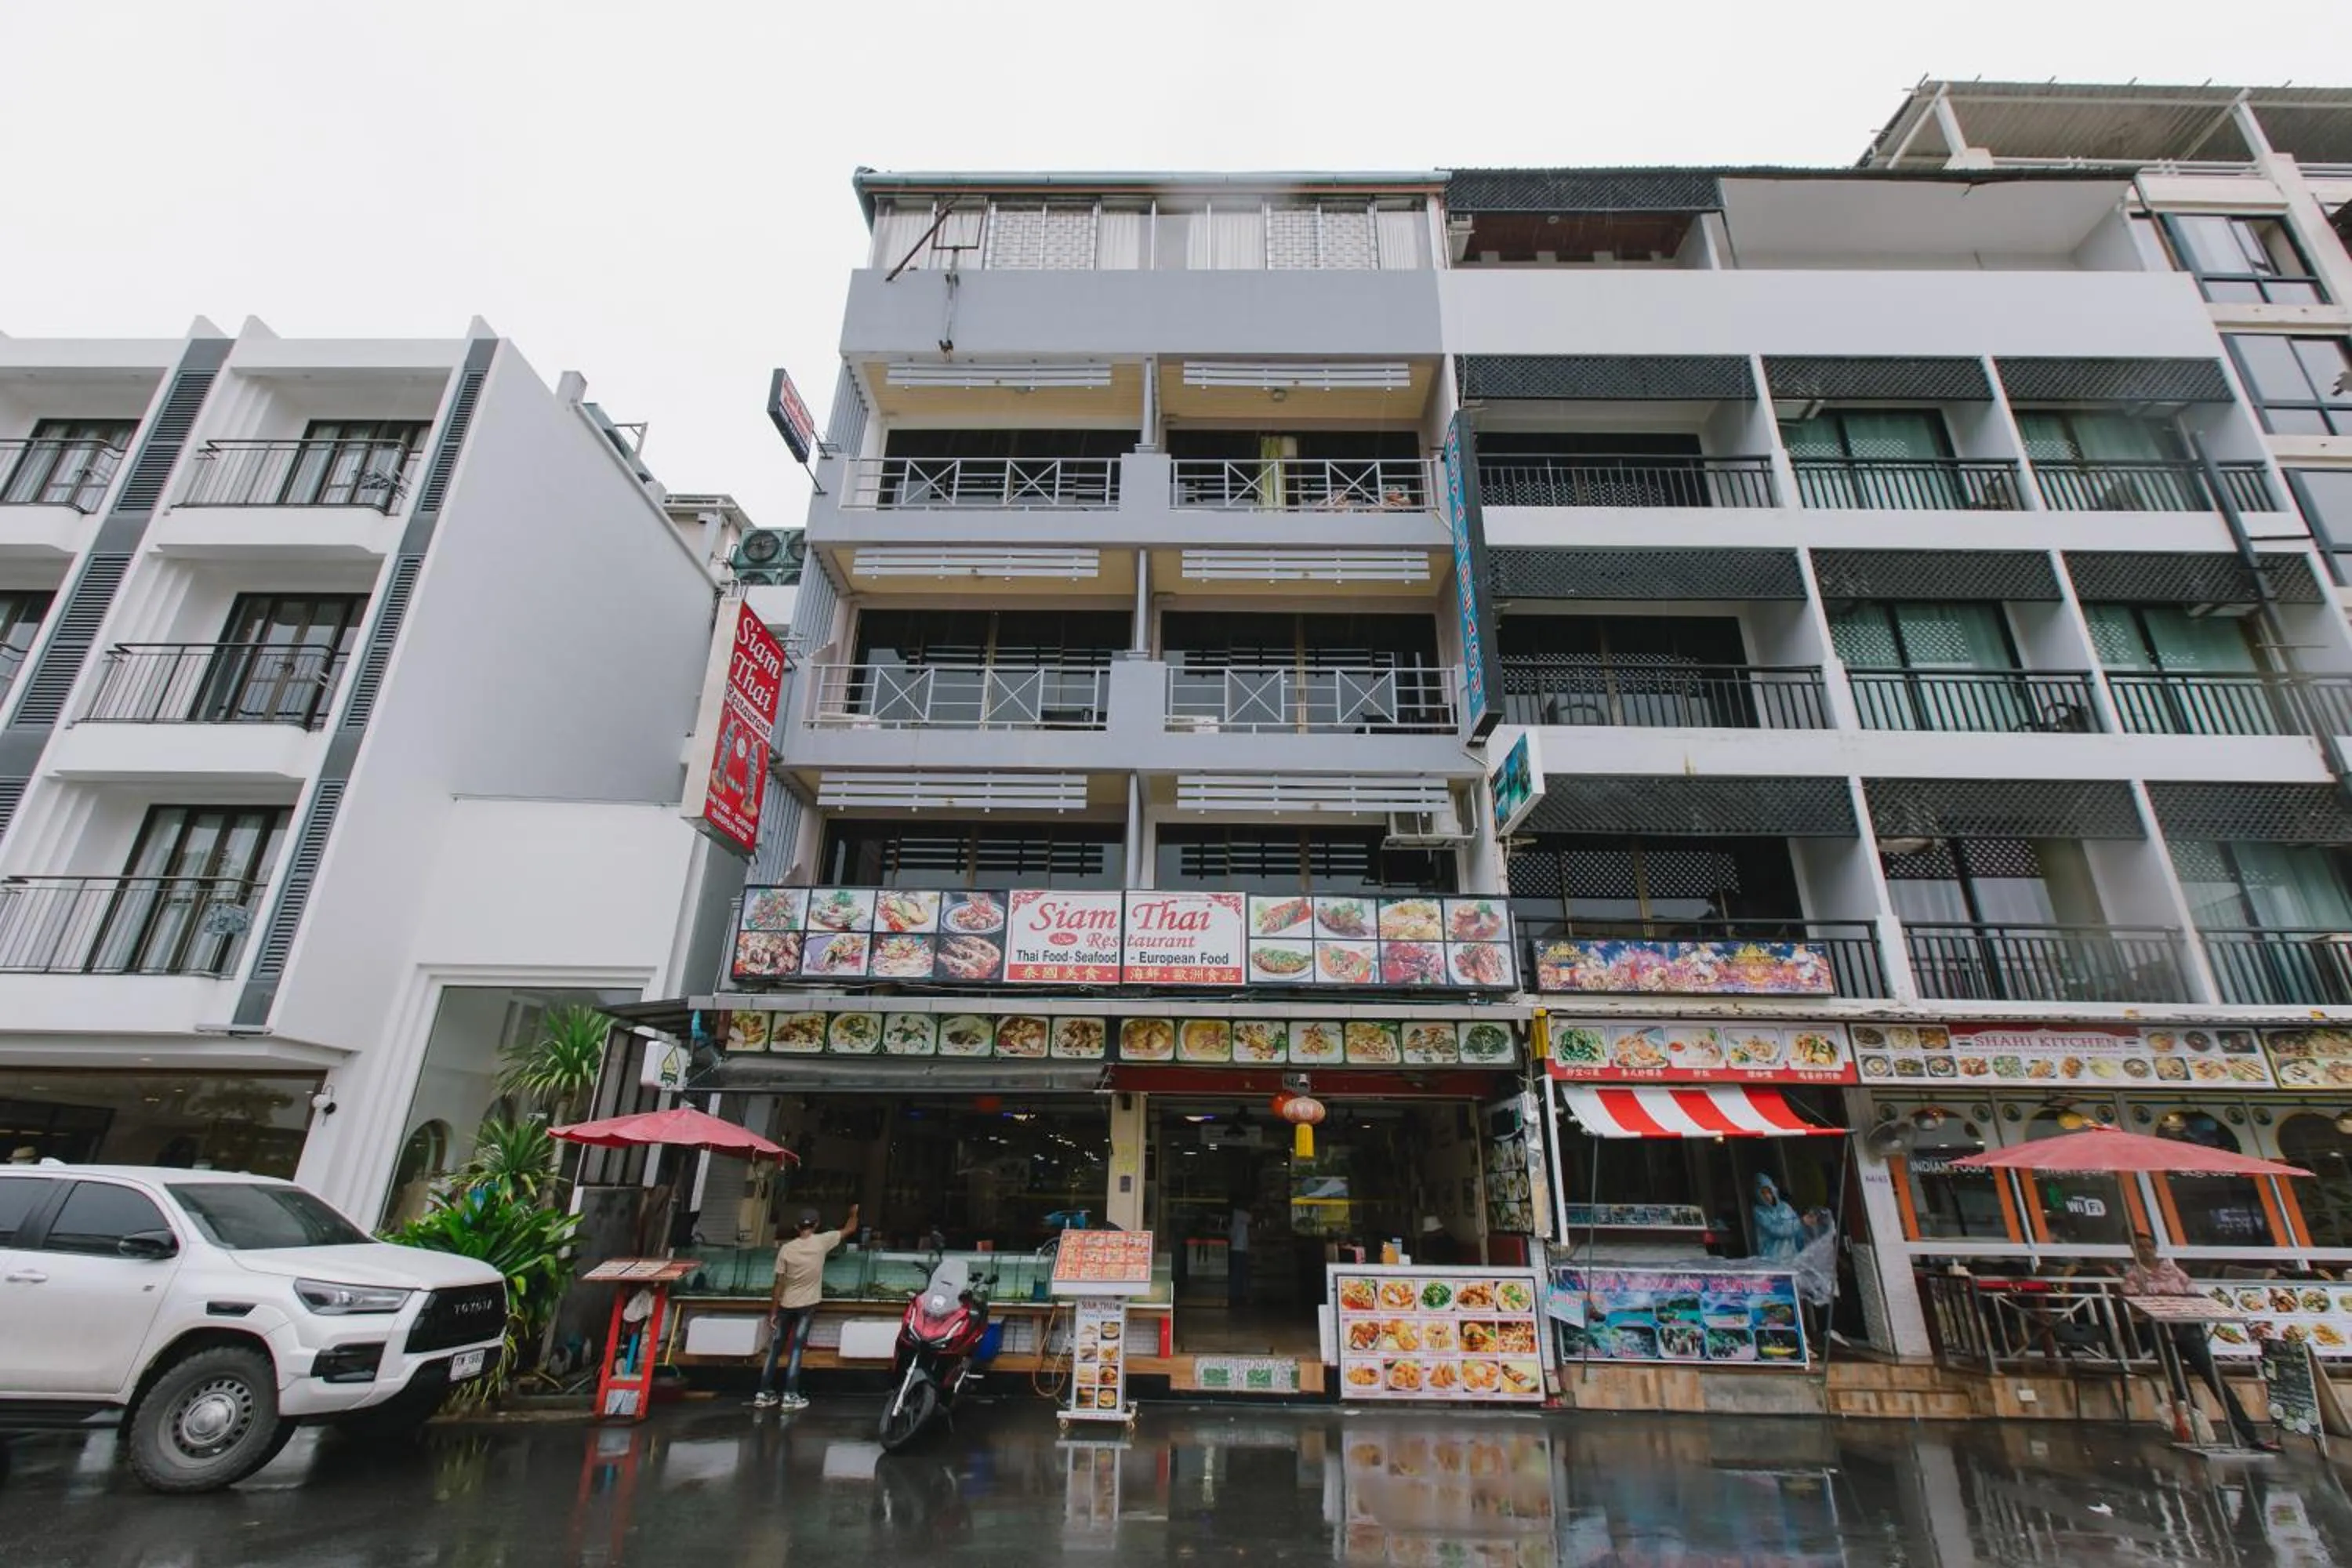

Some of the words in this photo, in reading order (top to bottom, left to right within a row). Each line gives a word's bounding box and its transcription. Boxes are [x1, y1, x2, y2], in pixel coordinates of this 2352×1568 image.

[736, 617, 779, 680] Siam
[733, 652, 775, 713] Thai
[725, 684, 772, 739] Restaurant
[1029, 902, 1117, 931] Siam
[1132, 899, 1214, 931] Thai
[1087, 932, 1196, 949] Restaurant
[1017, 949, 1039, 962] Thai
[1139, 951, 1196, 964] European
[1200, 952, 1229, 965] Food
[1973, 1035, 2033, 1047] SHAHI
[2039, 1036, 2120, 1048] KITCHEN
[1910, 1160, 1948, 1174] INDIAN
[454, 1298, 492, 1315] TOYOTA
